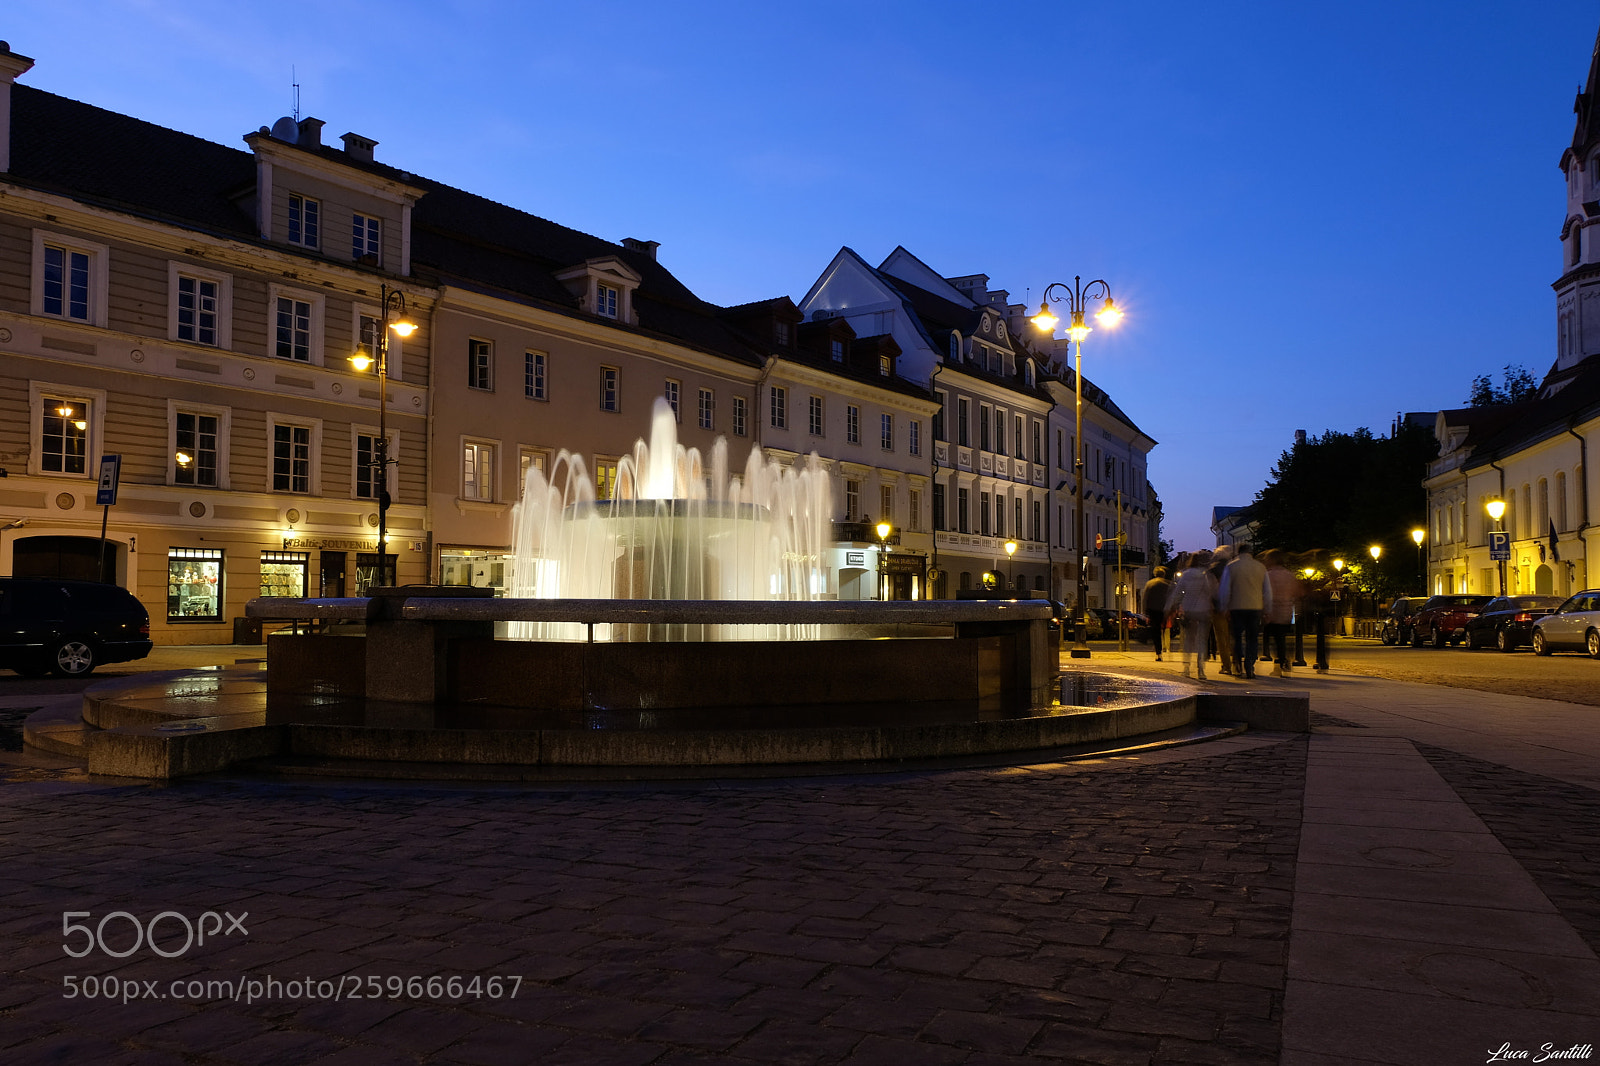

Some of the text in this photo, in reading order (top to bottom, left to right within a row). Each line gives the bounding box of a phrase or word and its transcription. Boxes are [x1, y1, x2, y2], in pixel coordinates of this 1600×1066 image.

[293, 539, 319, 548] Baltic
[415, 542, 421, 551] 15
[1493, 534, 1506, 550] P
